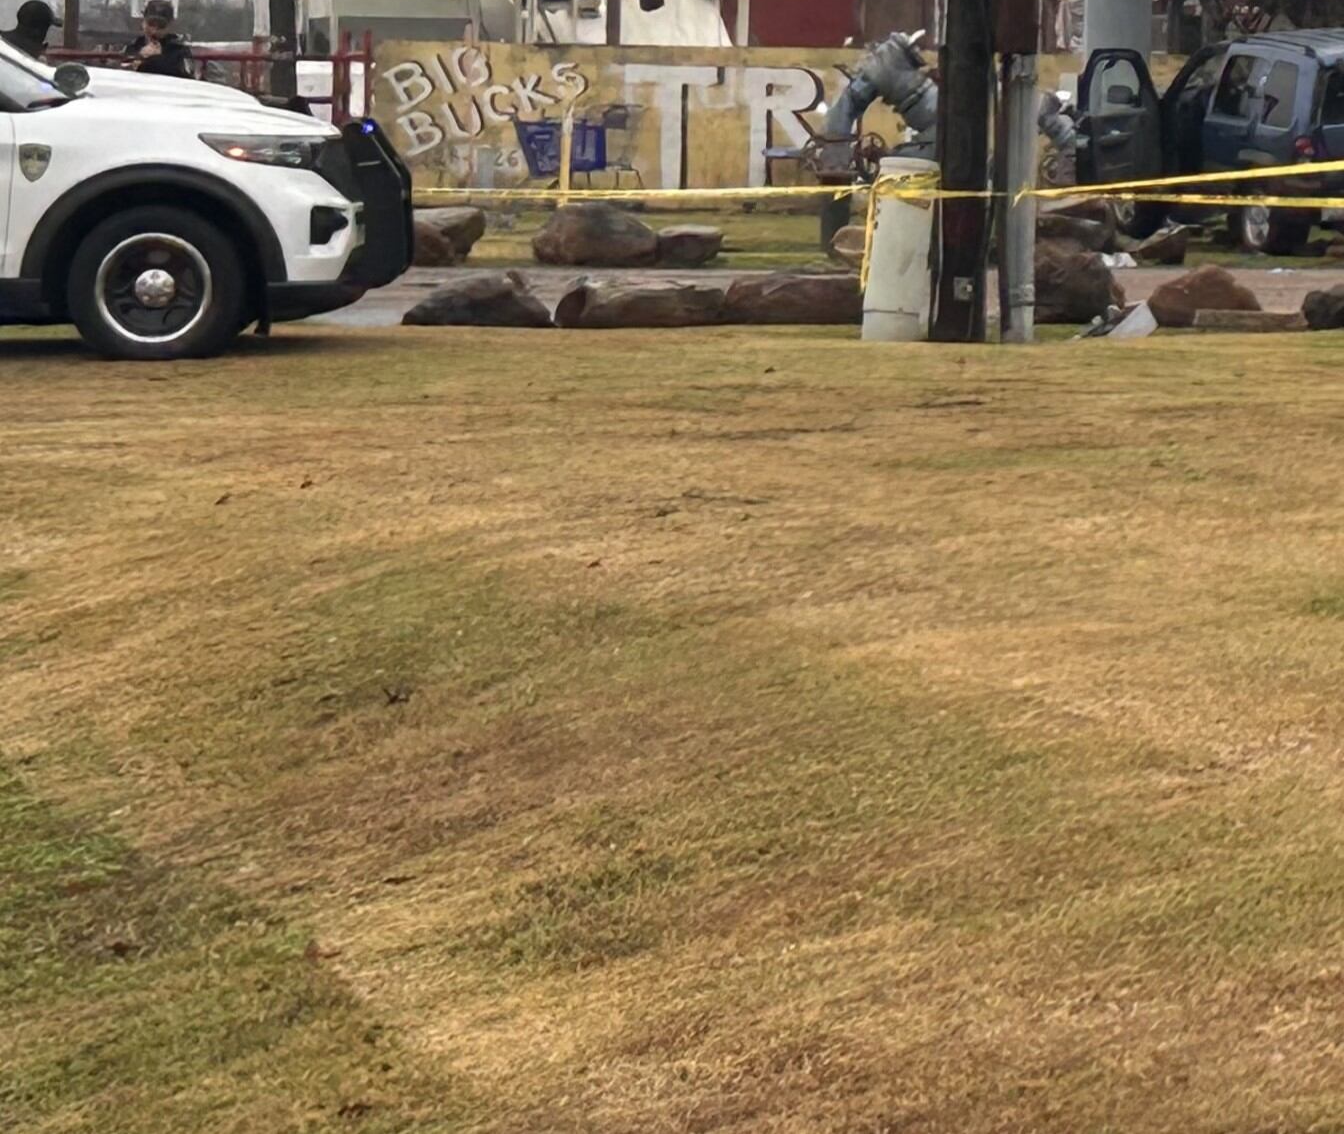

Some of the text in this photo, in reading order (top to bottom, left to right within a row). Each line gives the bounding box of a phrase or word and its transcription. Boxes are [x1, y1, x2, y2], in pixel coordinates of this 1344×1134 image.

[382, 46, 589, 157] BIG BUCKS
[623, 62, 852, 188] TR
